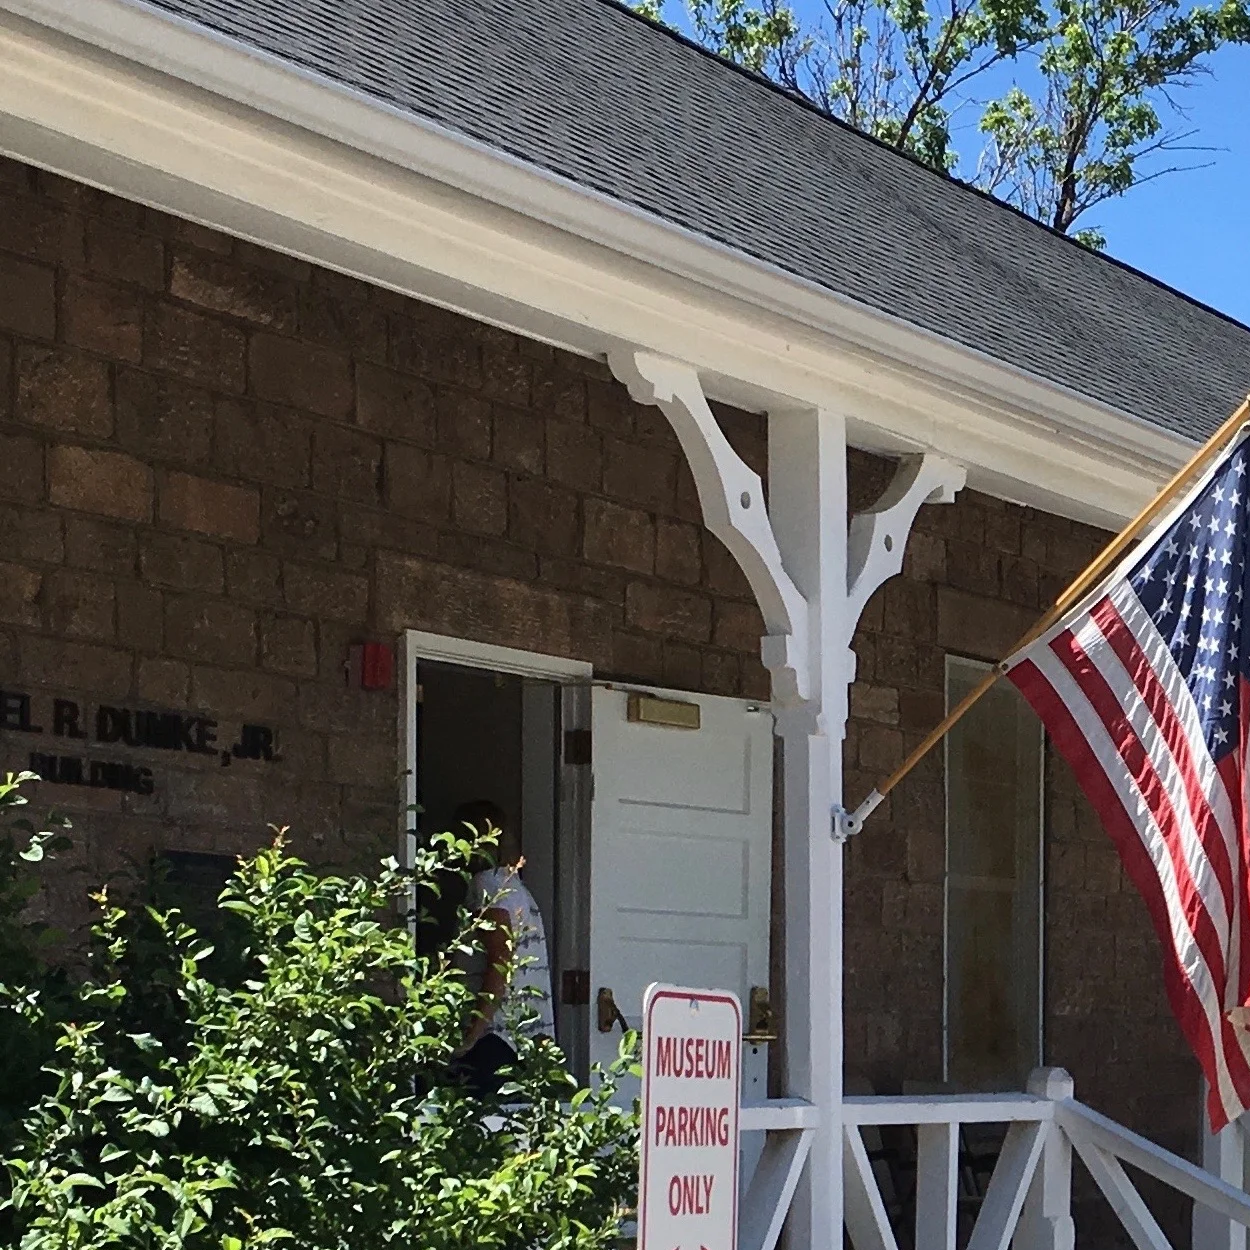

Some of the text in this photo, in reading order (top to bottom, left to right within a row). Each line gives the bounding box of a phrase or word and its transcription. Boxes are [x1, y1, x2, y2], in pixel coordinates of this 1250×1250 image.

[655, 1036, 731, 1080] MUSEUM
[655, 1106, 729, 1147] PARKING
[668, 1174, 715, 1216] ONLY
